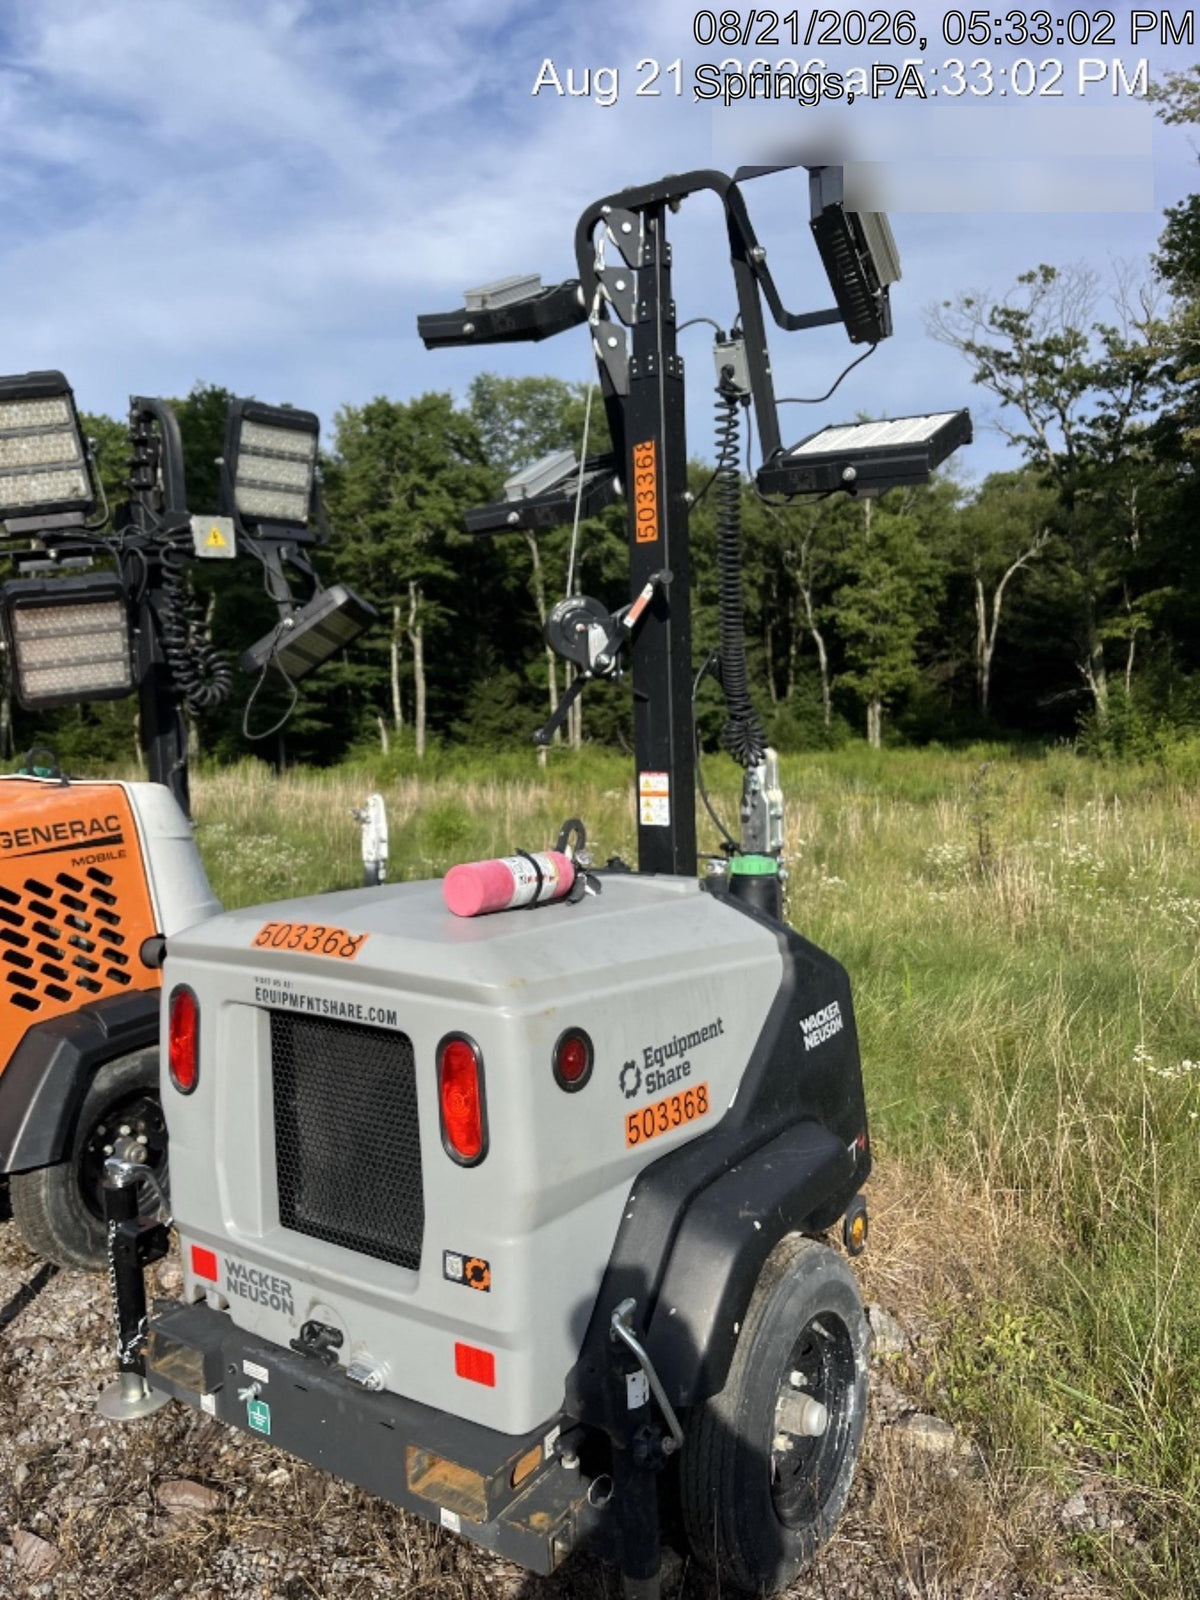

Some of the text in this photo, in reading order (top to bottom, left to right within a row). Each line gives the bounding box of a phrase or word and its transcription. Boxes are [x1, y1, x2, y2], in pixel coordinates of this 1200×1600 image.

[636, 441, 656, 539] 503368
[0, 815, 121, 849] GENERAC
[71, 849, 127, 867] MOBILE
[255, 923, 363, 957] 503368
[799, 1001, 841, 1033] WACKER
[803, 1015, 843, 1050] NEUSON
[643, 1017, 724, 1069] Equipment
[645, 1060, 691, 1094] Share
[627, 1085, 708, 1145] 503368
[224, 1258, 293, 1299] WACKER
[226, 1276, 295, 1316] NEUSON
